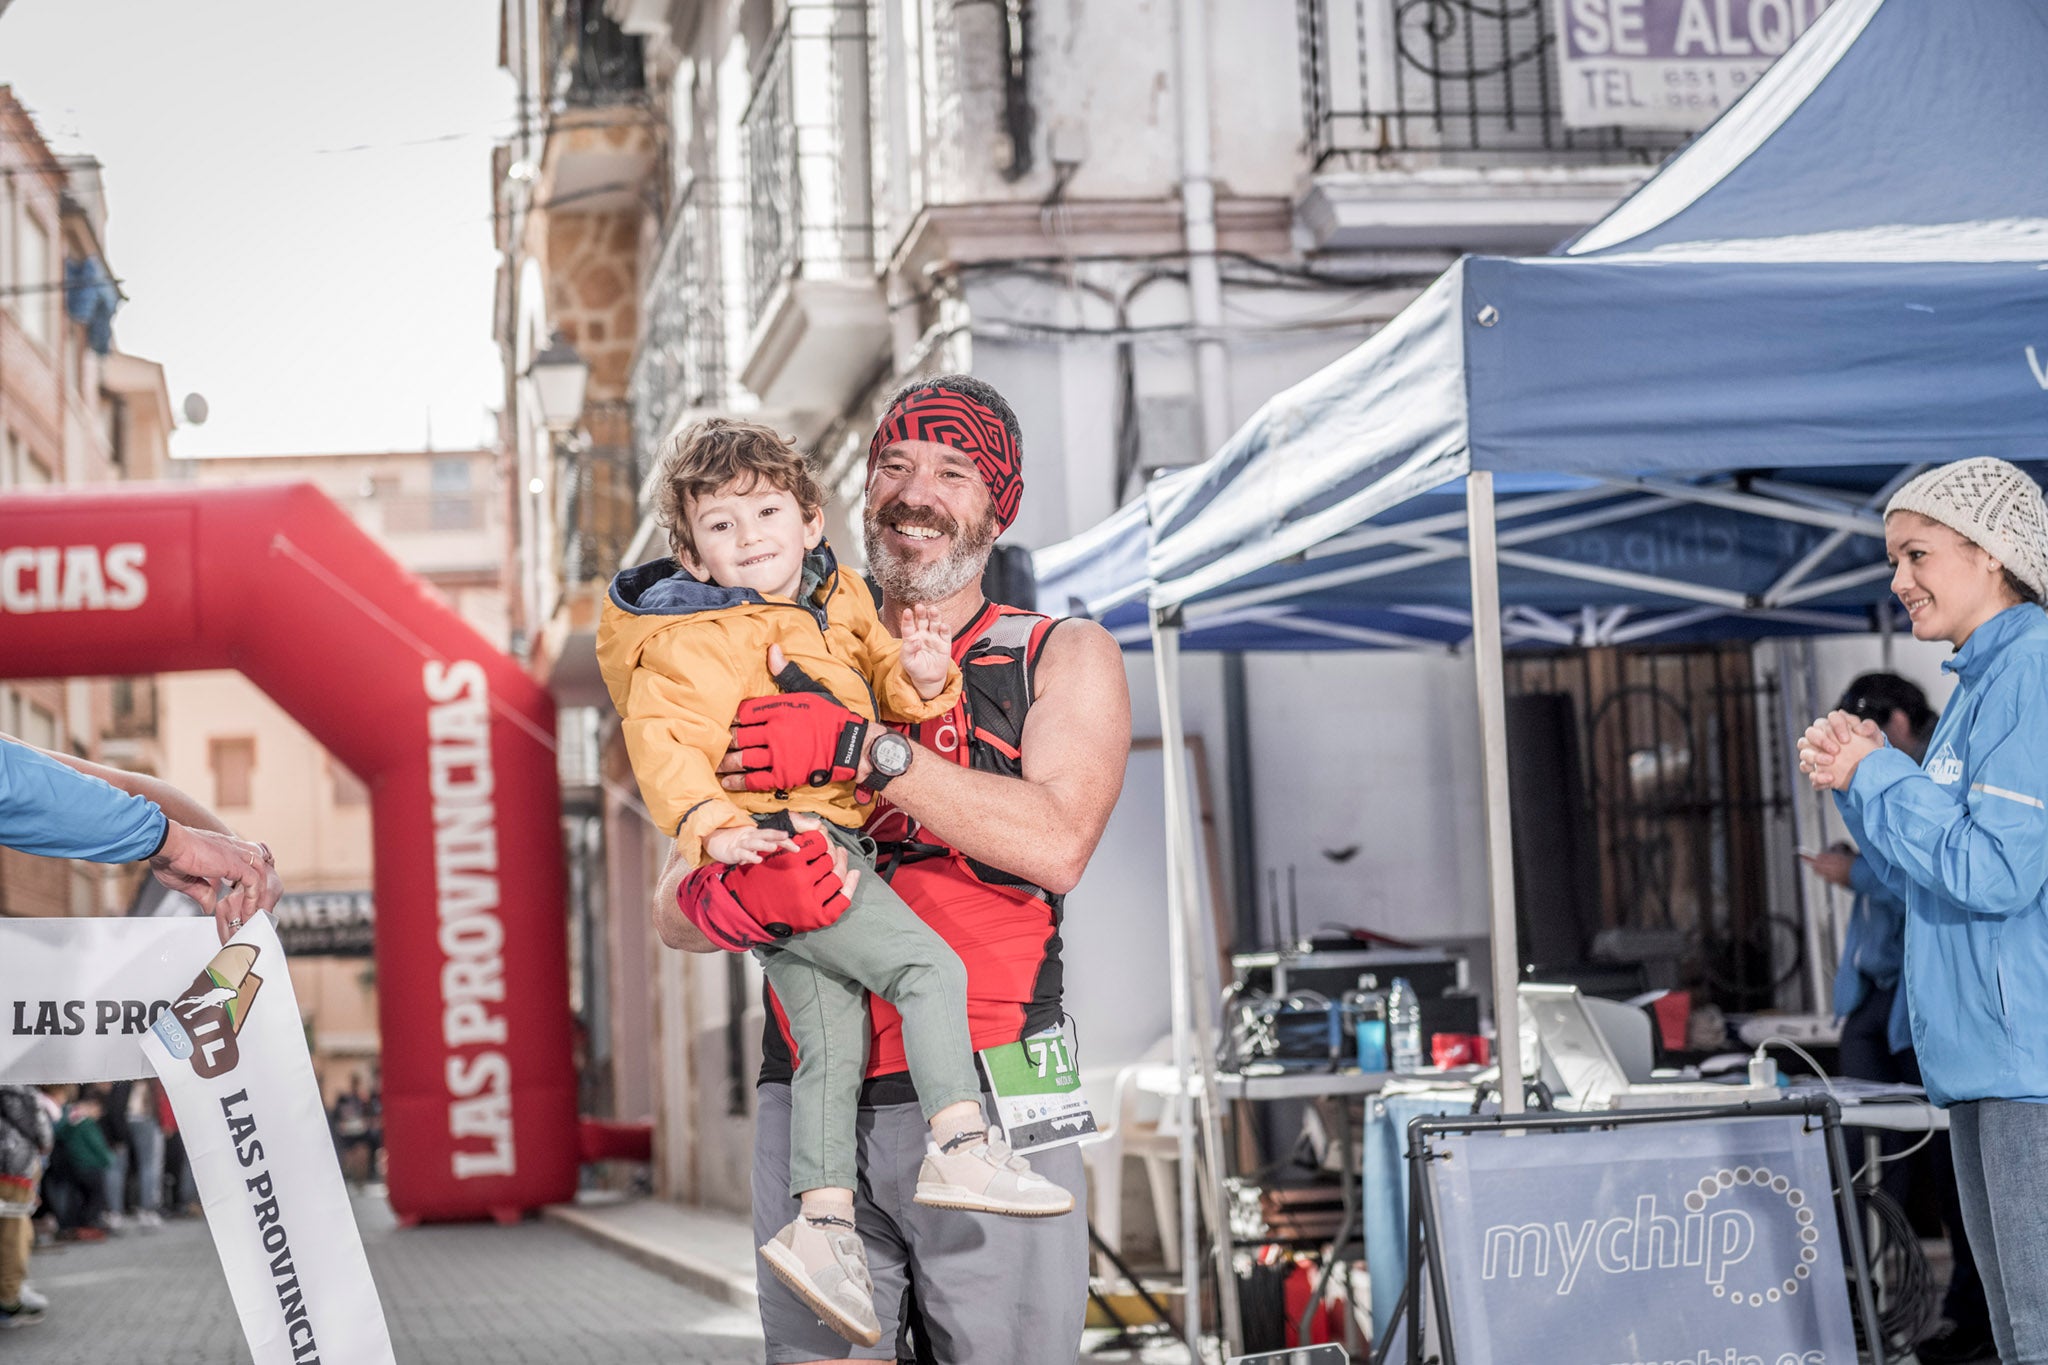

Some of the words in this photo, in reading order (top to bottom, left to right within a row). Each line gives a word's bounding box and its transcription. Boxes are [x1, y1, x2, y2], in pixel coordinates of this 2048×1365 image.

[1572, 0, 1649, 54] SE
[0, 542, 148, 614] CIAS
[423, 659, 507, 1048] PROVINCIAS
[12, 1001, 85, 1036] LAS
[219, 1088, 264, 1168] LAS
[445, 1052, 516, 1179] LAS
[1482, 1193, 1756, 1295] mychip
